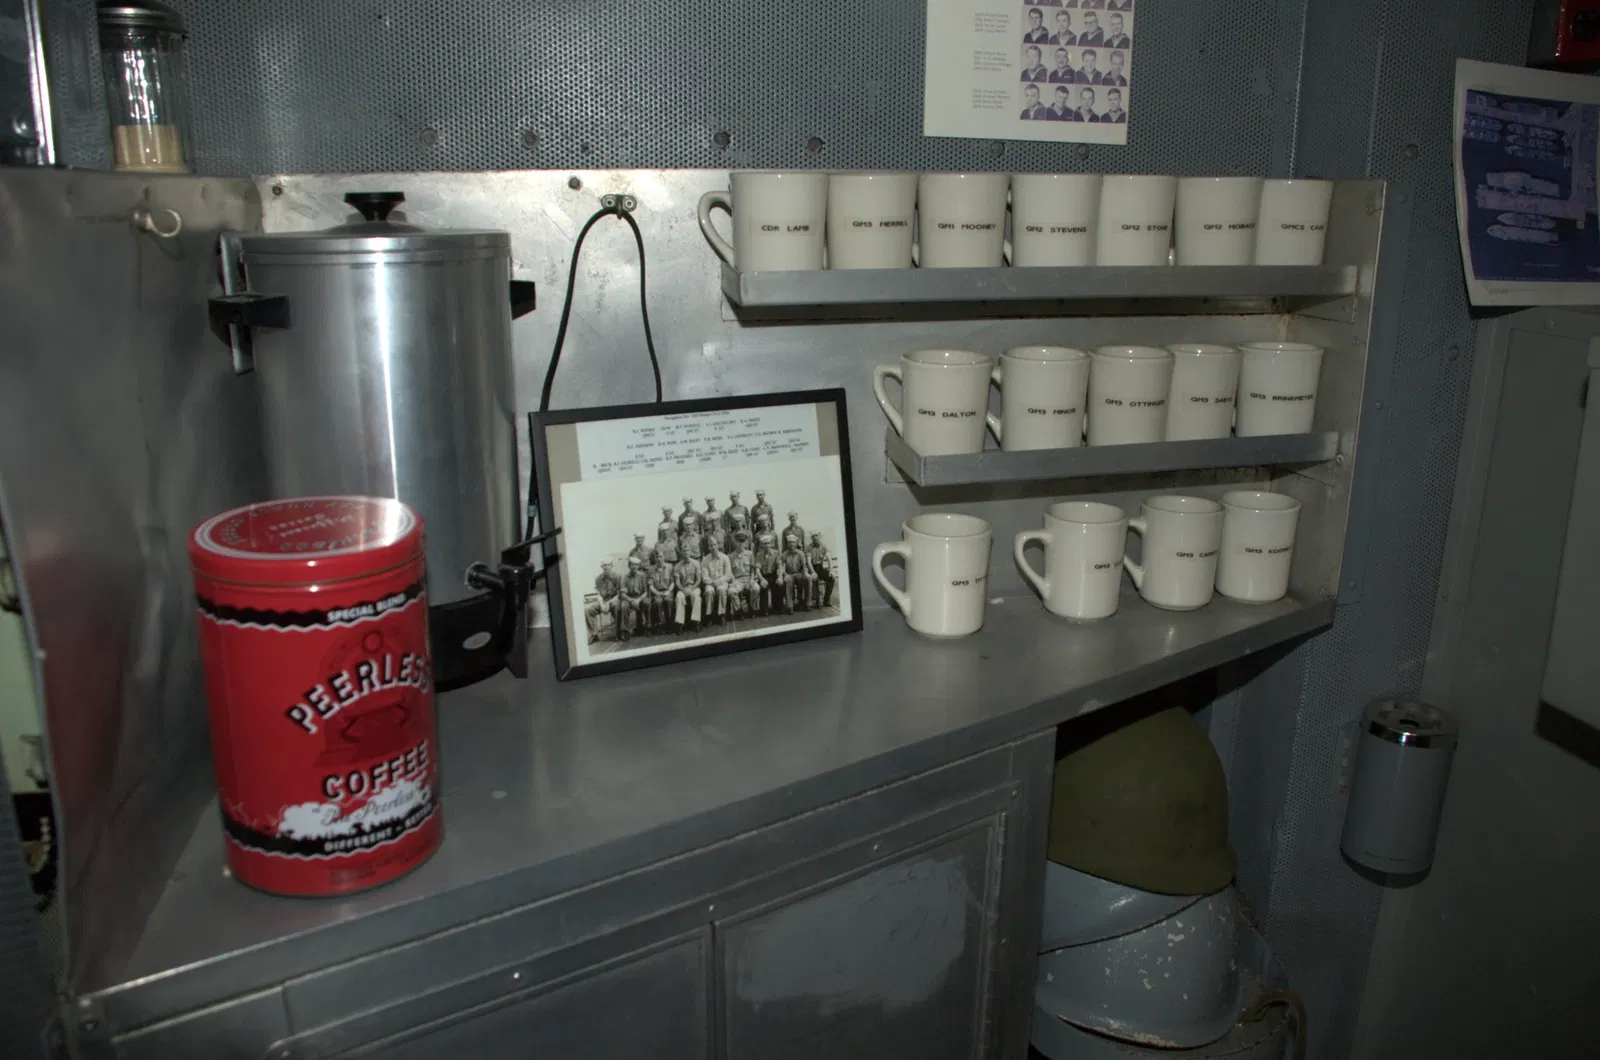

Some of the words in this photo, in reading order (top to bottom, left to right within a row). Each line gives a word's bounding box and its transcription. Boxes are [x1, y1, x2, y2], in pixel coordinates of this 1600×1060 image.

[761, 224, 780, 232] CDR
[787, 224, 810, 232] LAMB
[961, 222, 997, 231] MOONEY
[1050, 225, 1088, 233] STEVENS
[942, 410, 977, 418] DALTON
[327, 603, 375, 622] SPECIAL
[376, 592, 406, 612] BLEND
[322, 739, 430, 801] COFFEE
[324, 827, 393, 852] DIFFERENT
